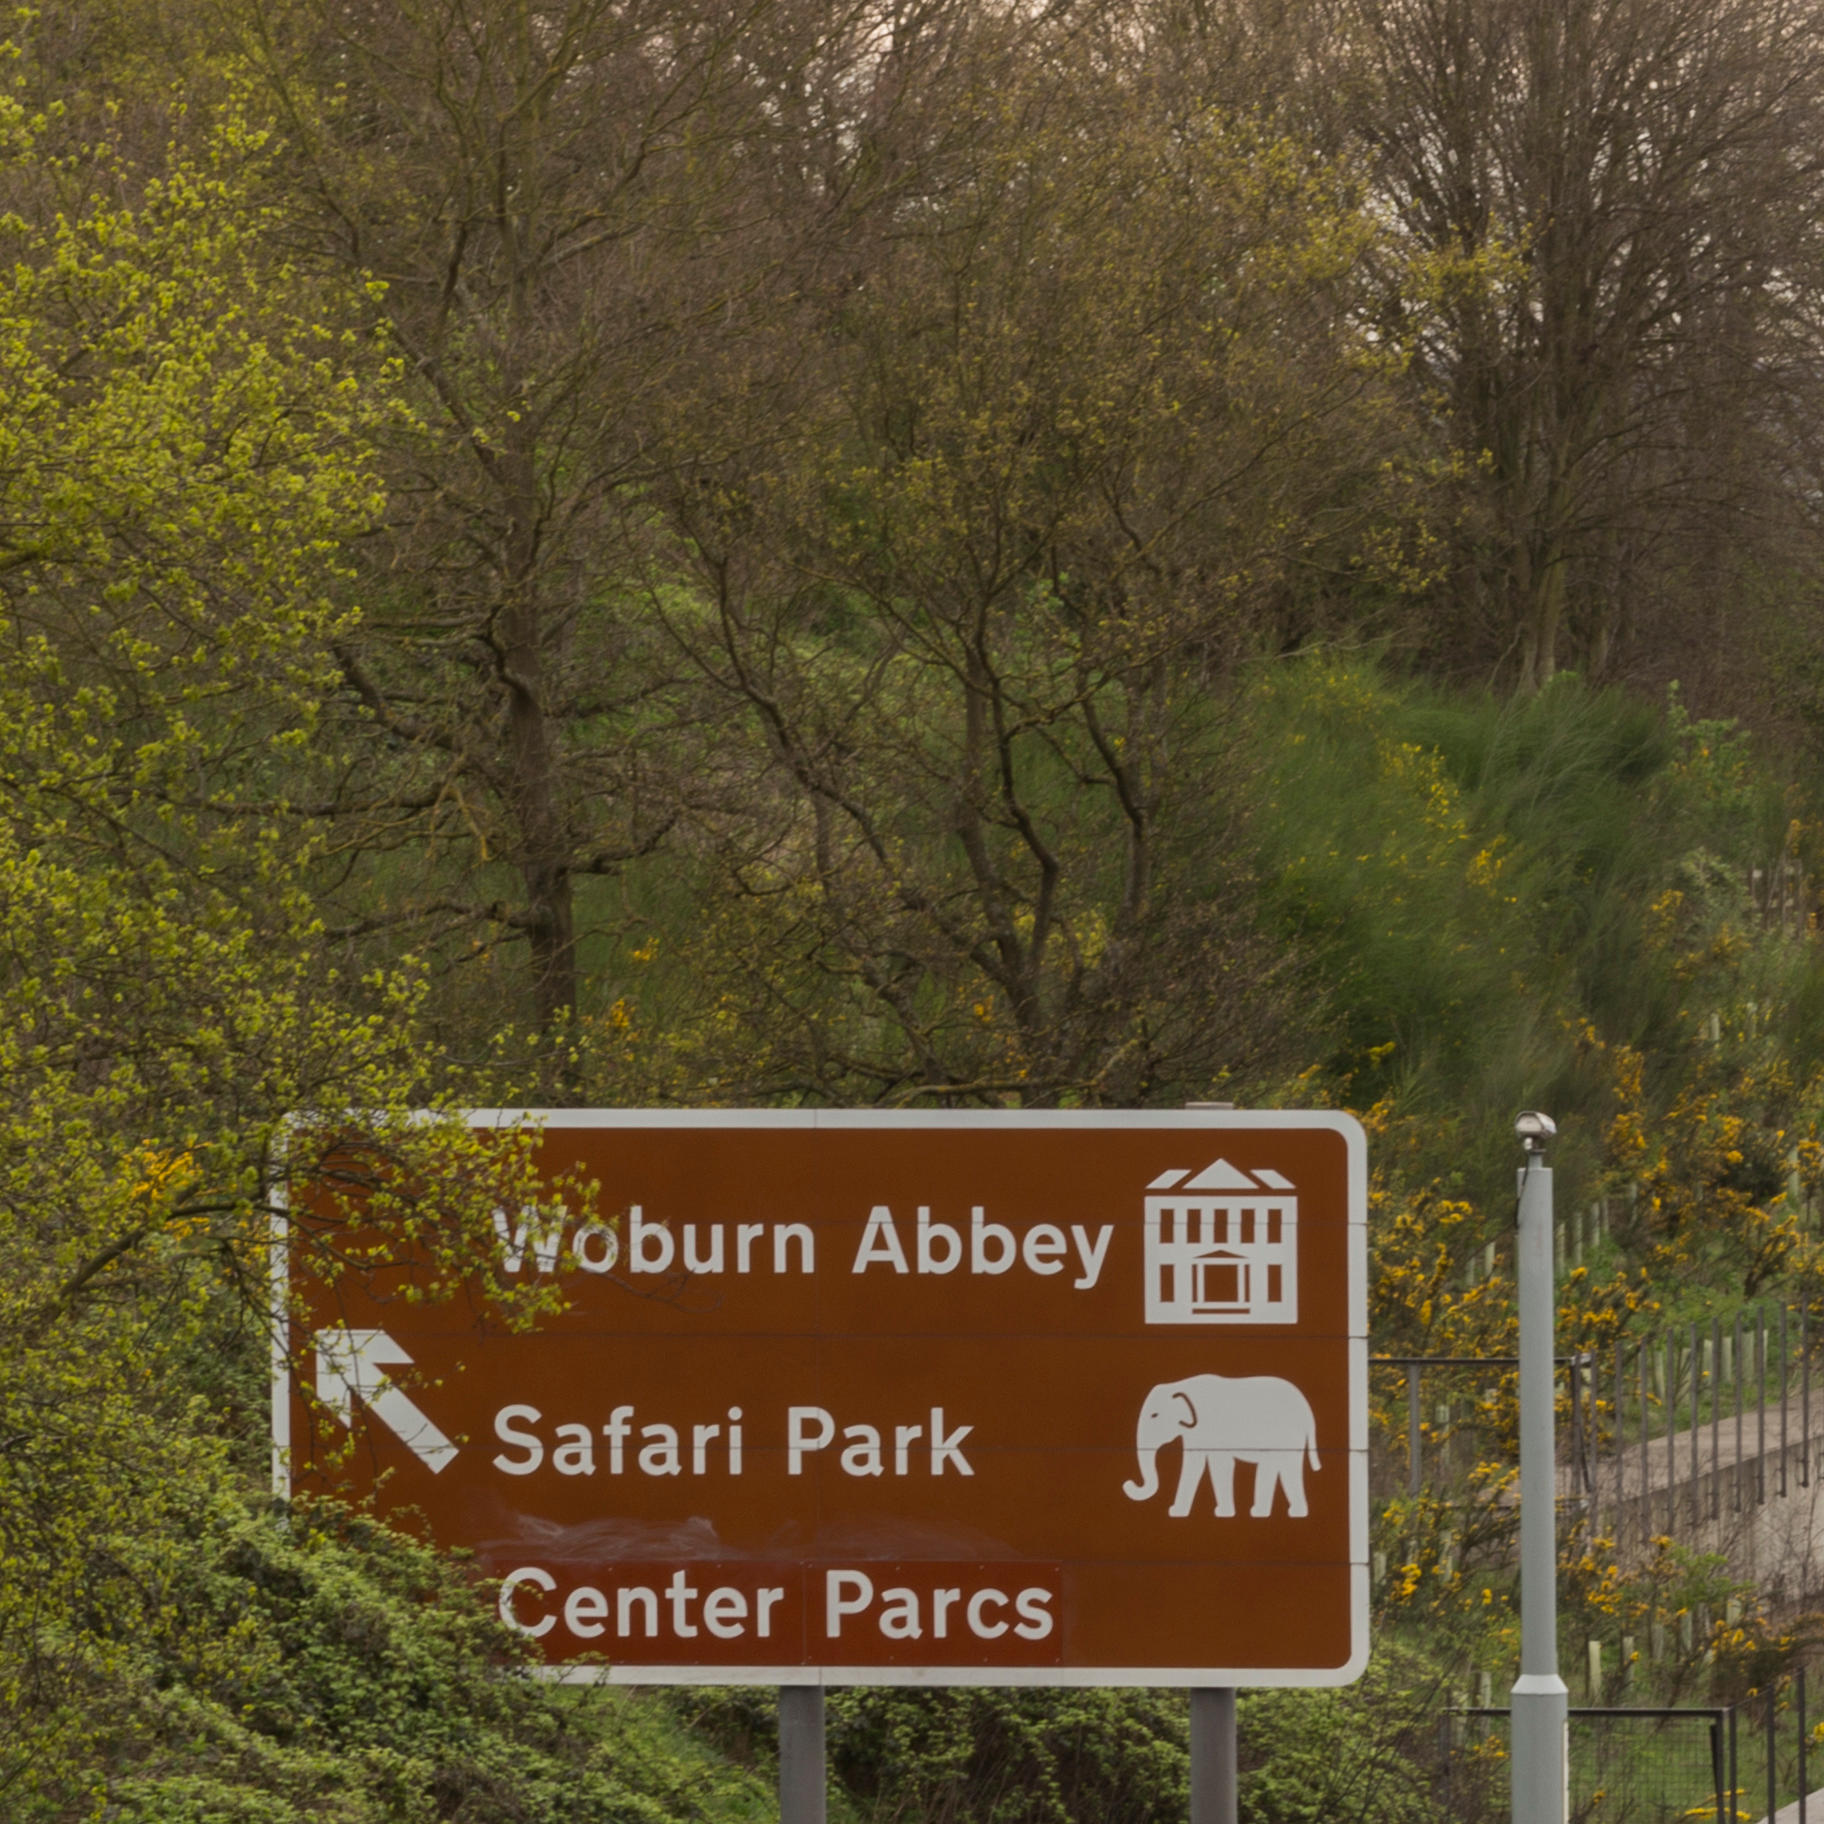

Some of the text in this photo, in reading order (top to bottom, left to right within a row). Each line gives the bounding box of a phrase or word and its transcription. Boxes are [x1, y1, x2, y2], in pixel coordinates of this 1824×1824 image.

[492, 1204, 1115, 1290] Woburn Abbey
[492, 1403, 975, 1477] Safari Park
[498, 1566, 1054, 1641] Center Parcs
